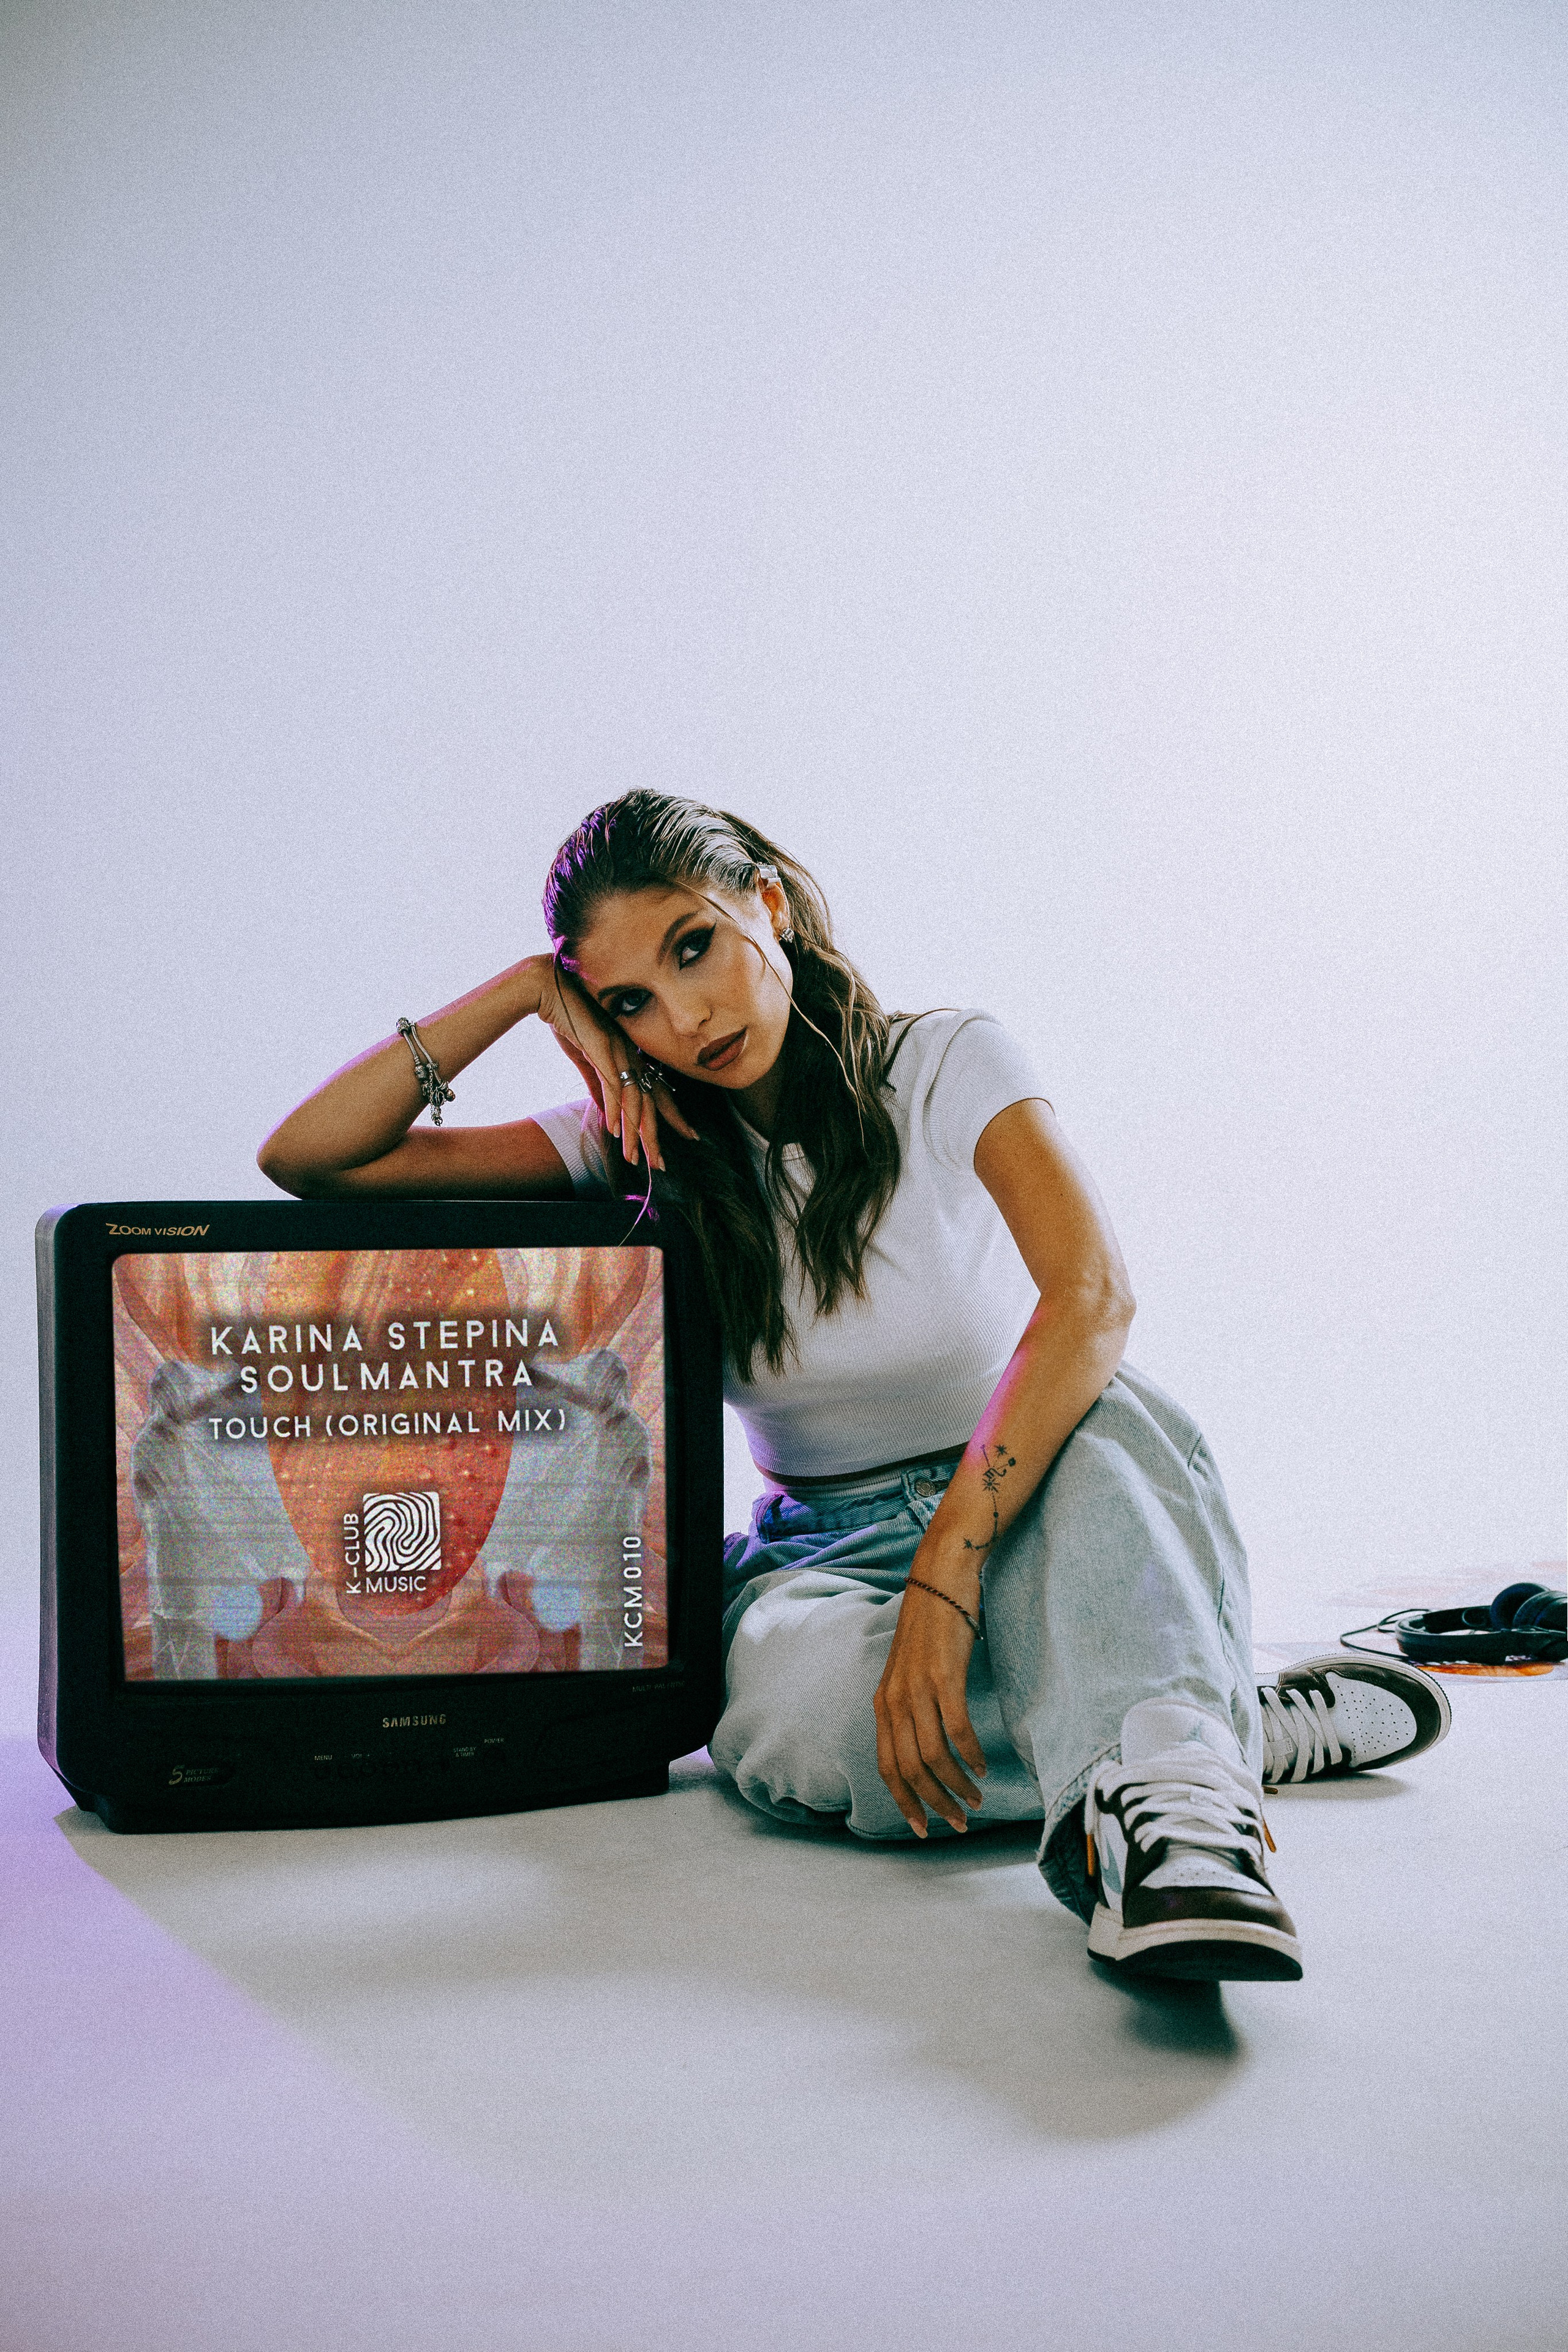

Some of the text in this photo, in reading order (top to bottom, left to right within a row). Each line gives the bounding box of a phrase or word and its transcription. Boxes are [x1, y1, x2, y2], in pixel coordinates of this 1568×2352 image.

[105, 1223, 210, 1237] ZOOM VISION
[211, 1319, 559, 1355] KARINA STEPINA
[240, 1359, 532, 1393] SOULMANTRA
[209, 1409, 565, 1440] TOUCH (ORIGINAL MIX)
[344, 1512, 361, 1594] K-CLUB
[366, 1575, 426, 1593] MUSIC
[623, 1536, 643, 1647] KCM010
[382, 1714, 447, 1728] SAMSUNG
[168, 1765, 185, 1785] 5
